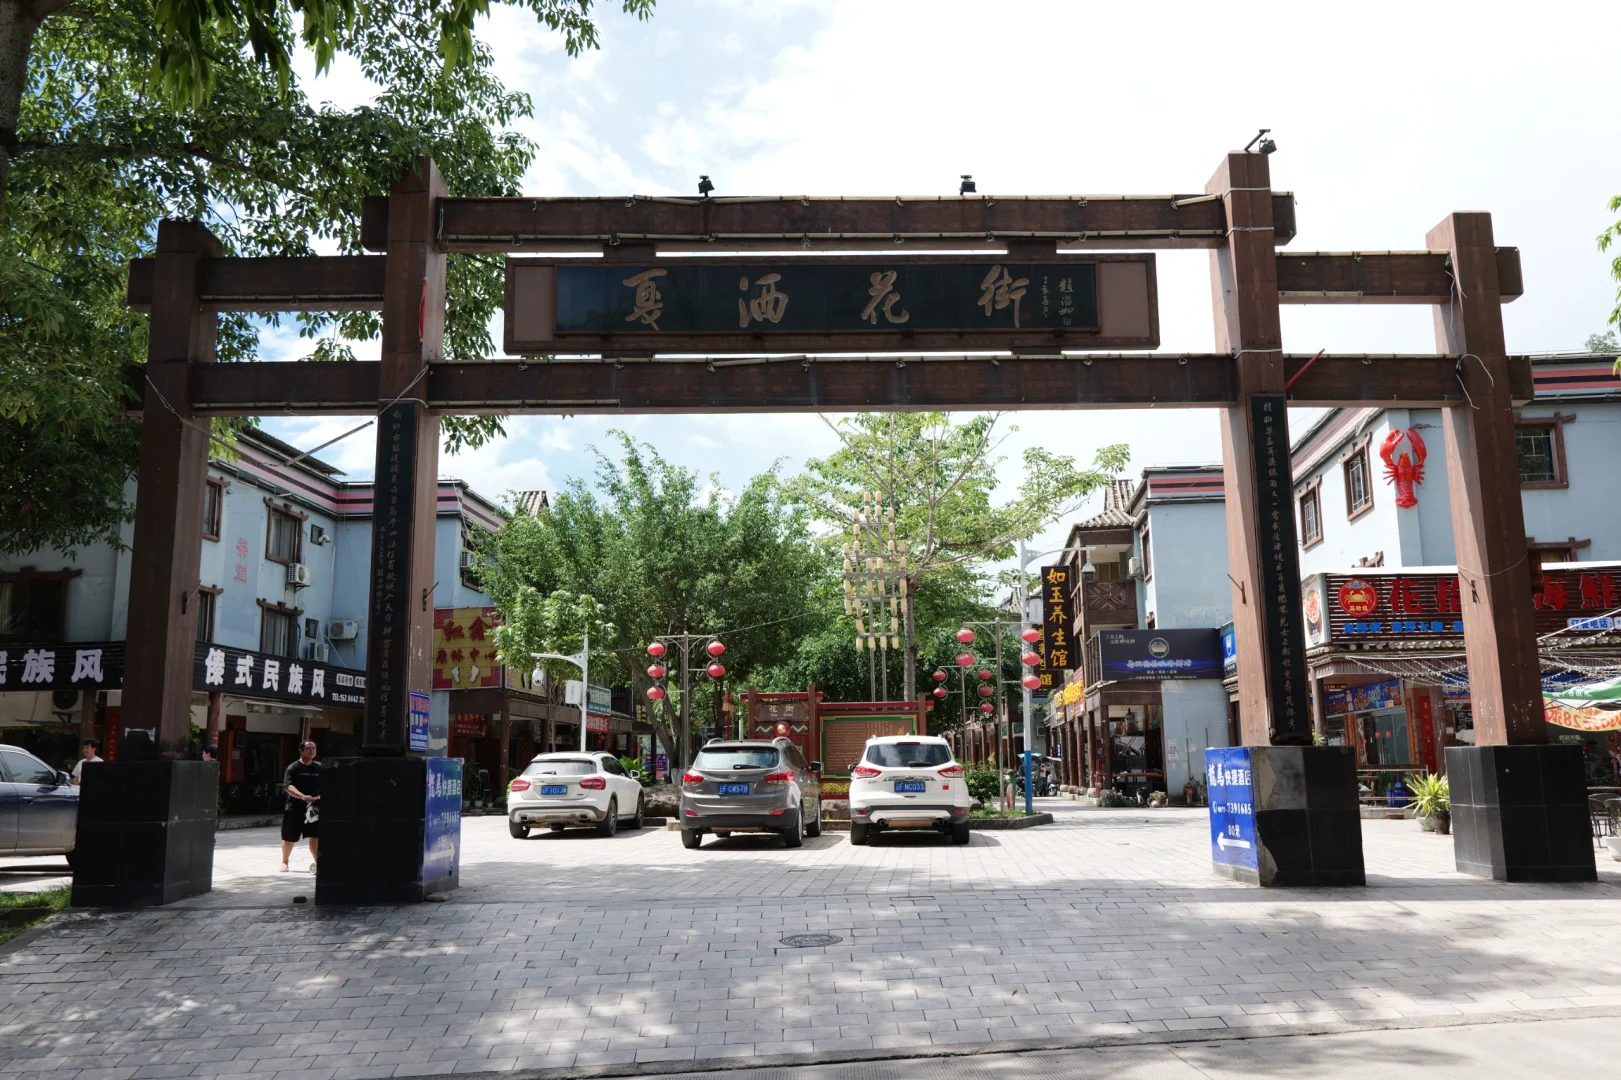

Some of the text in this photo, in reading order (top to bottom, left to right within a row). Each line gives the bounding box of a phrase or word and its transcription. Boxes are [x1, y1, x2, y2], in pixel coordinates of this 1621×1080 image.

[1047, 568, 1068, 667] 如玉养生馆
[0, 648, 104, 685] 族风
[205, 647, 325, 699] 傣式民族风
